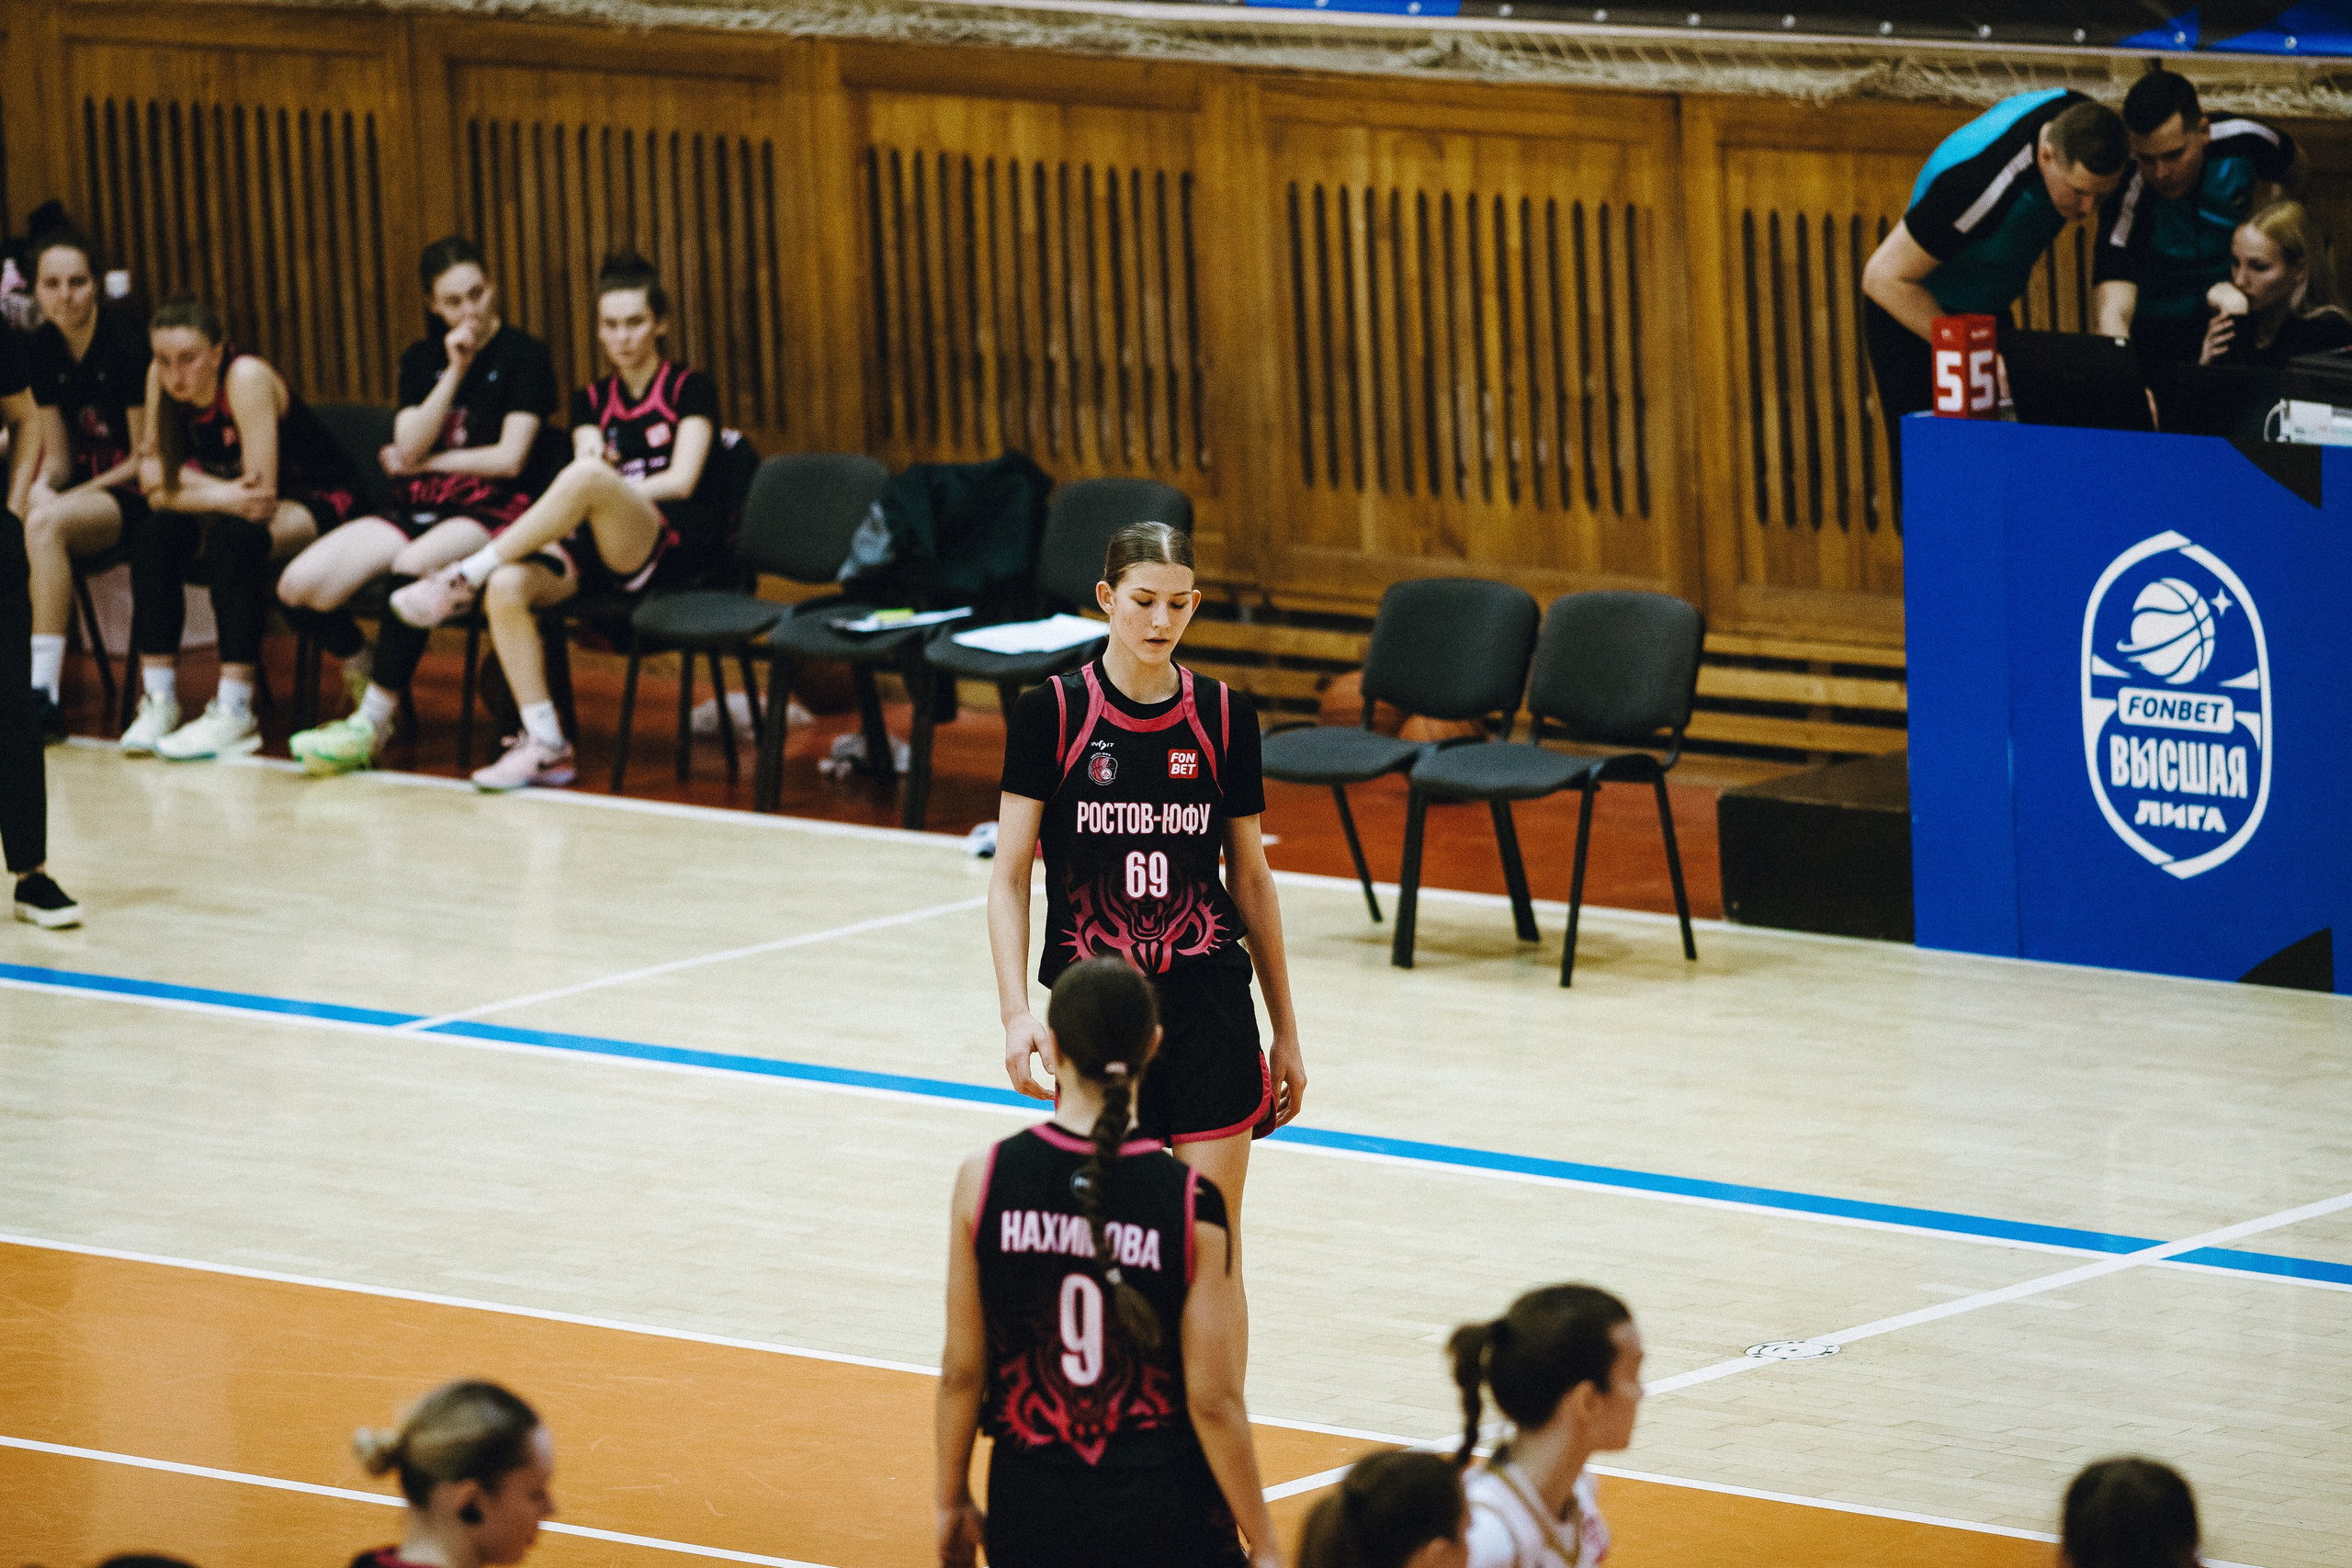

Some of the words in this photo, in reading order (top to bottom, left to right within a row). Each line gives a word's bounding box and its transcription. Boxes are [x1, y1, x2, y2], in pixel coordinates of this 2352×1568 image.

[1936, 350, 1962, 412] 5
[1969, 350, 1995, 411] 5
[2129, 696, 2223, 724] FONBET
[1170, 752, 1195, 764] FON
[1170, 763, 1196, 775] BET
[2110, 734, 2248, 799] ВЫСШАЯ
[1076, 801, 1211, 835] РОСТОВ-ЮФУ
[2134, 800, 2227, 833] ЛИГА
[1125, 851, 1169, 898] 69
[1058, 1272, 1104, 1387] 9
